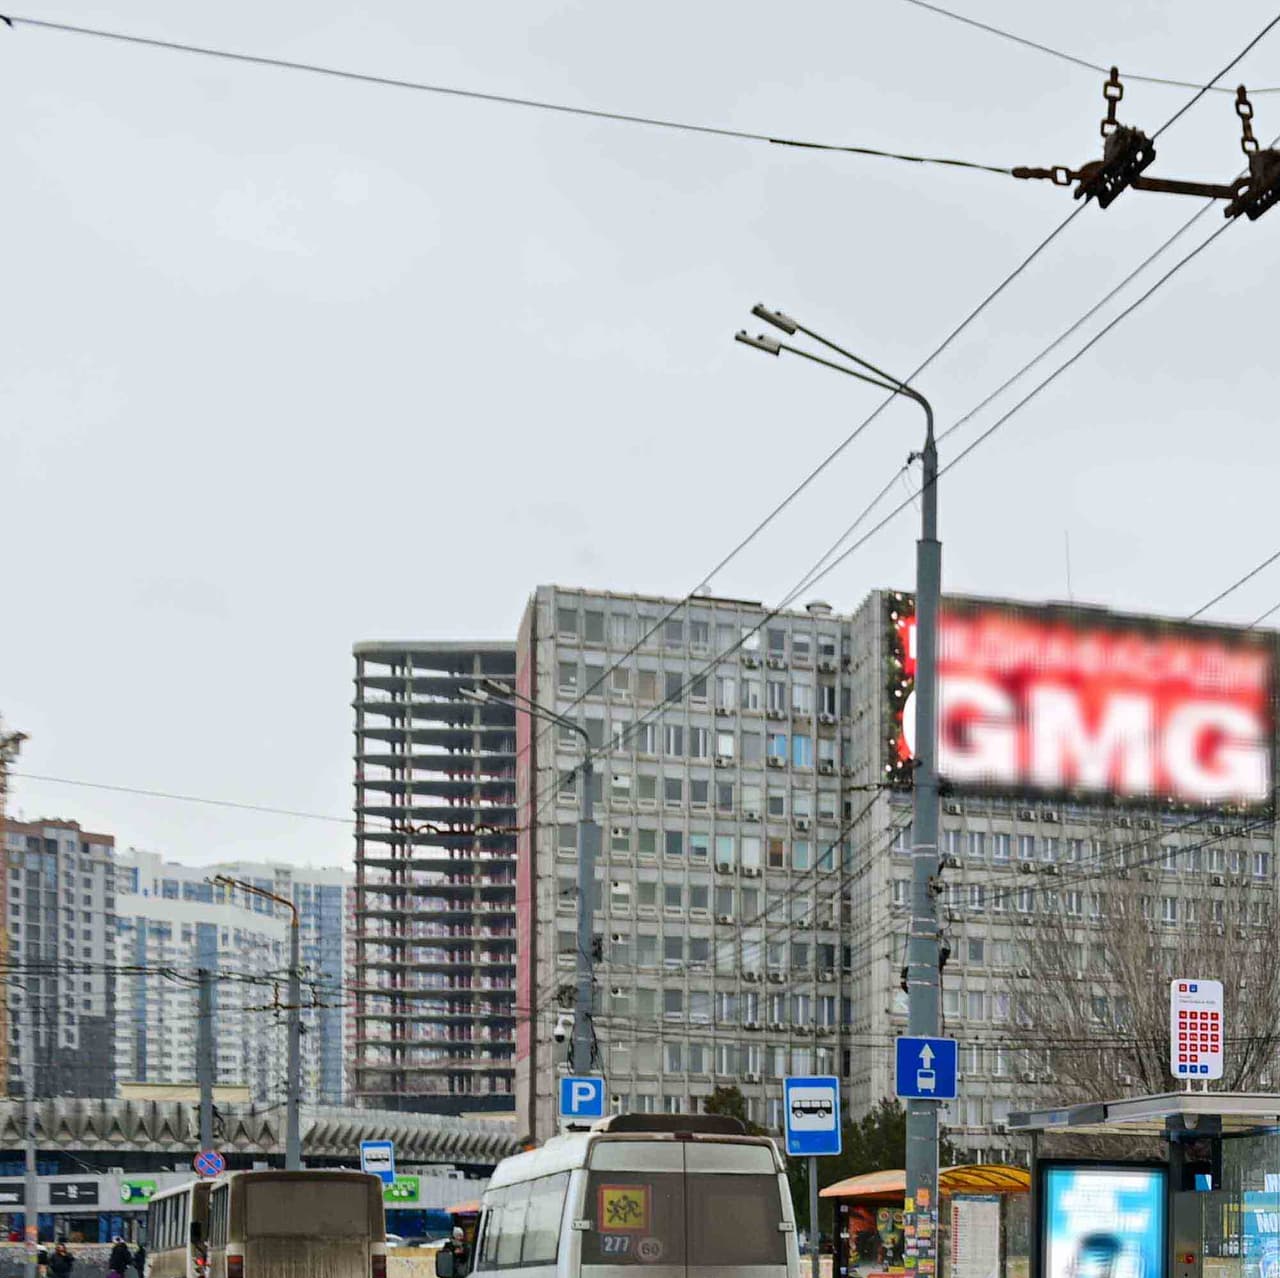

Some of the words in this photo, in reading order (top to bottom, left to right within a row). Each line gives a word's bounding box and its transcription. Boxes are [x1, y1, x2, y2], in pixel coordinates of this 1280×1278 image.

[937, 675, 1269, 802] GMG
[572, 1081, 596, 1113] P
[604, 1236, 629, 1252] 277
